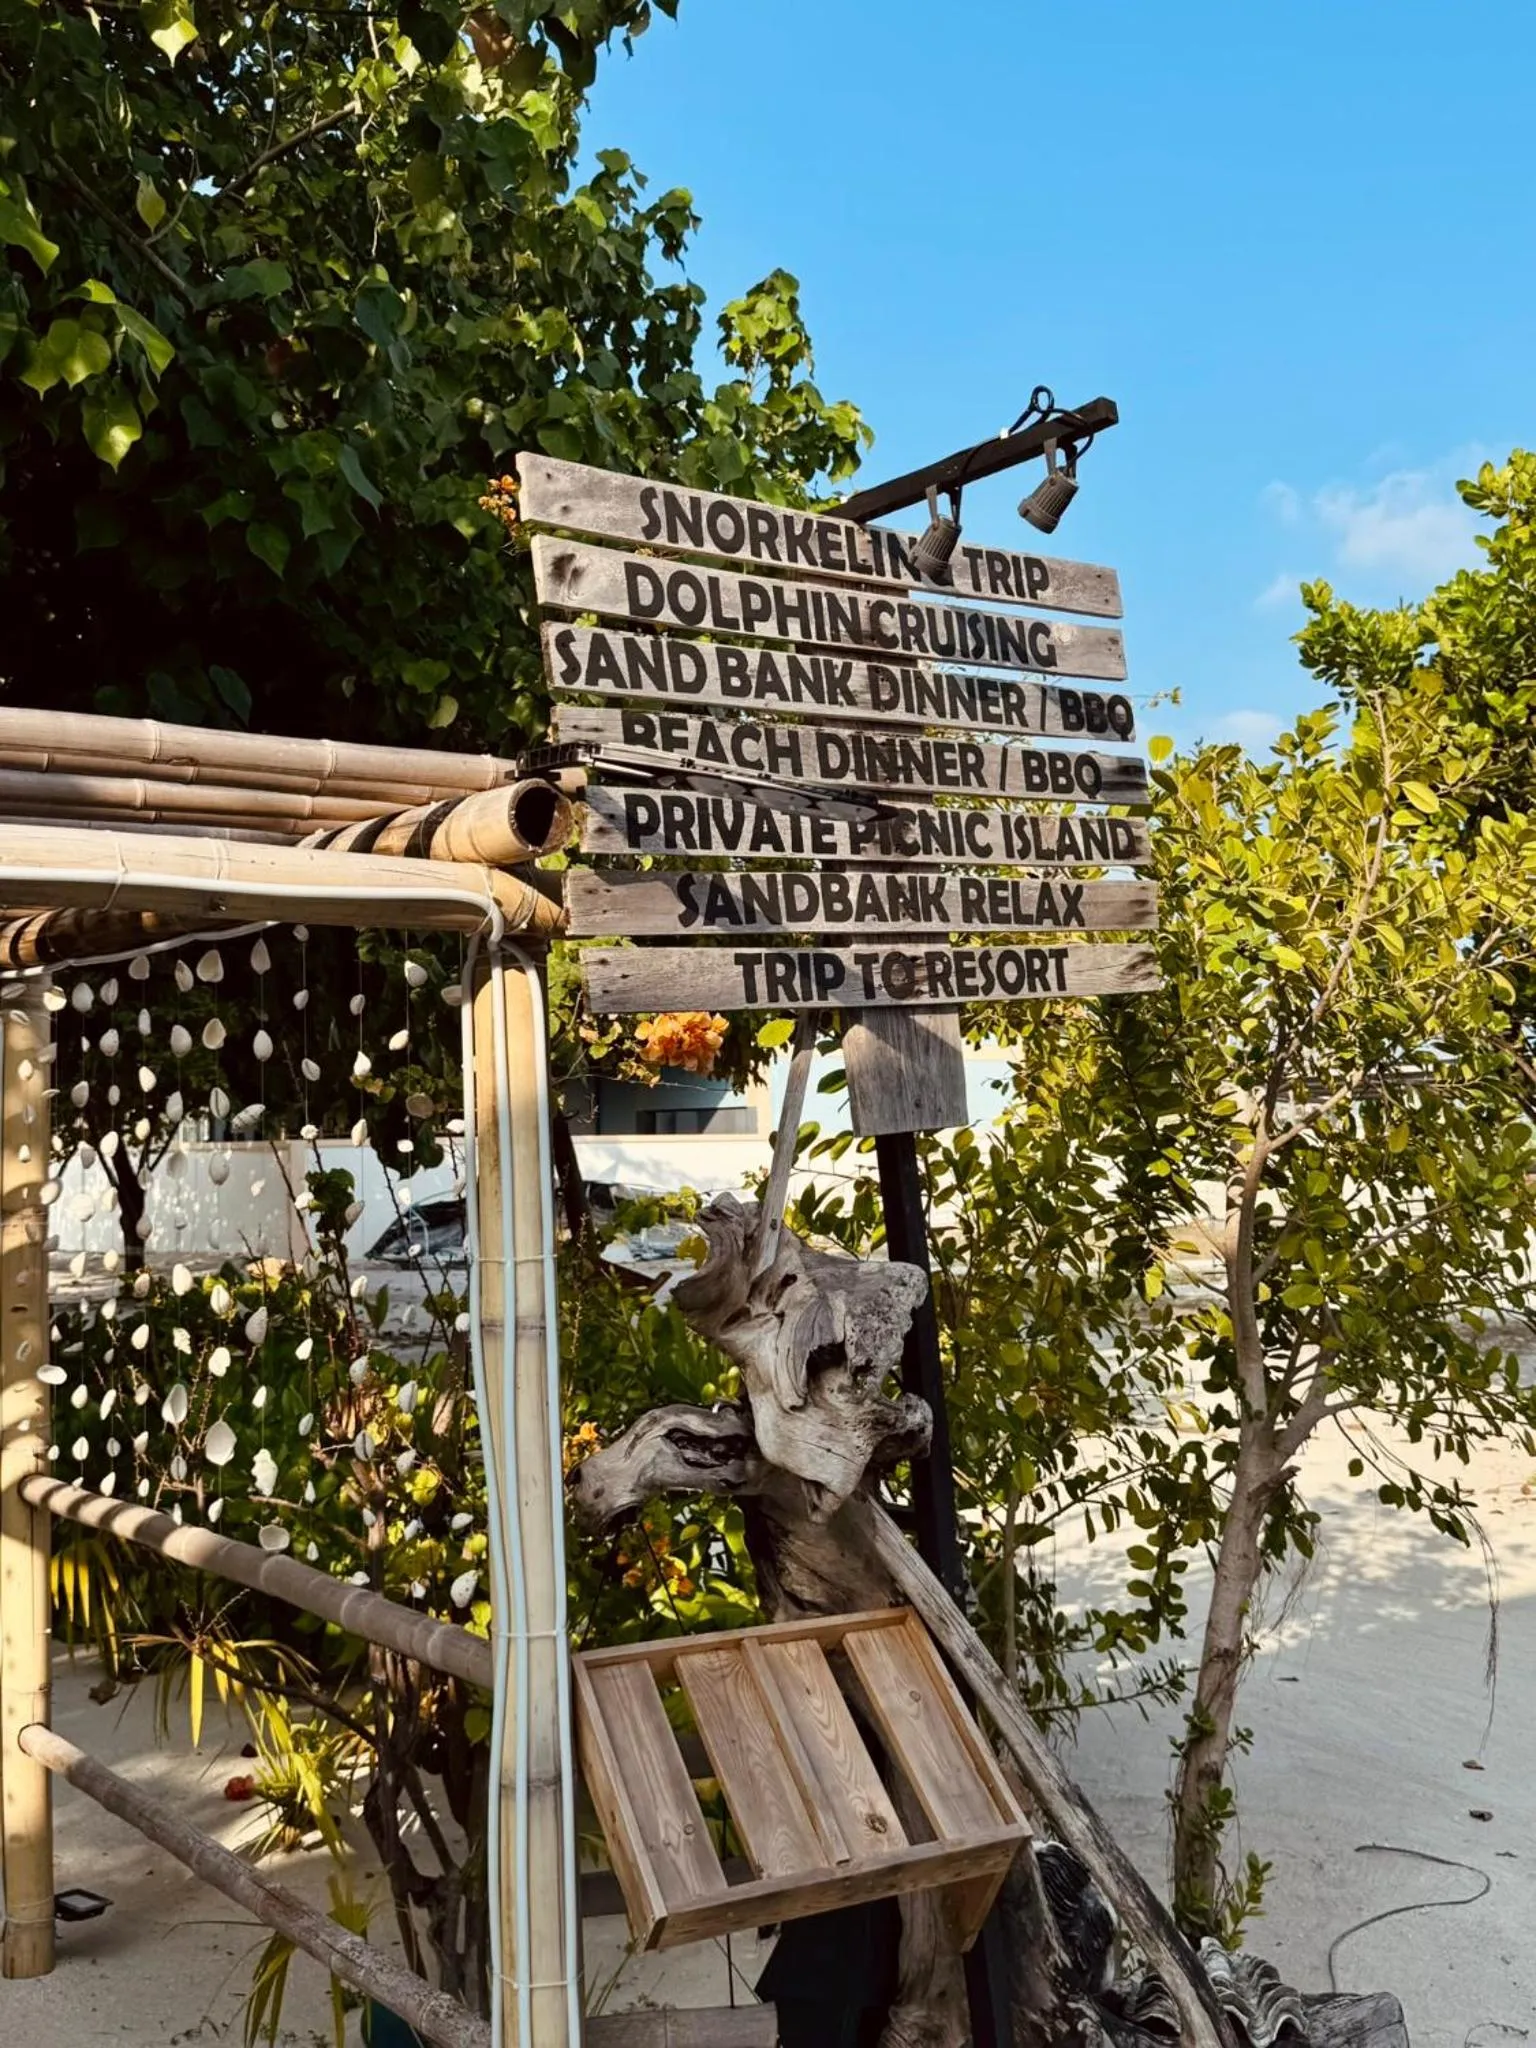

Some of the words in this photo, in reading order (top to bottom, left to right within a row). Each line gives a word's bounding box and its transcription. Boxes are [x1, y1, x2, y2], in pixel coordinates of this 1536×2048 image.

[638, 486, 954, 588] SNORKELIN
[961, 546, 1051, 601] TRIP
[623, 561, 864, 646] DOLPHIN
[869, 598, 1058, 668] CRUISING
[866, 663, 1029, 728] DINNER
[1058, 688, 1136, 742] BBQ
[620, 710, 805, 778] BEACH
[815, 731, 989, 789] DINNER
[1021, 750, 1104, 800] BBQ
[623, 793, 838, 855] PRIVATE
[848, 808, 994, 858] PICNIC
[1001, 813, 1138, 861] ISLAND
[676, 872, 951, 928] SANDBANK
[959, 876, 1086, 928] RELAX
[733, 951, 846, 1004] TRIP
[853, 950, 917, 1001] TO
[923, 948, 1070, 999] RESORT
